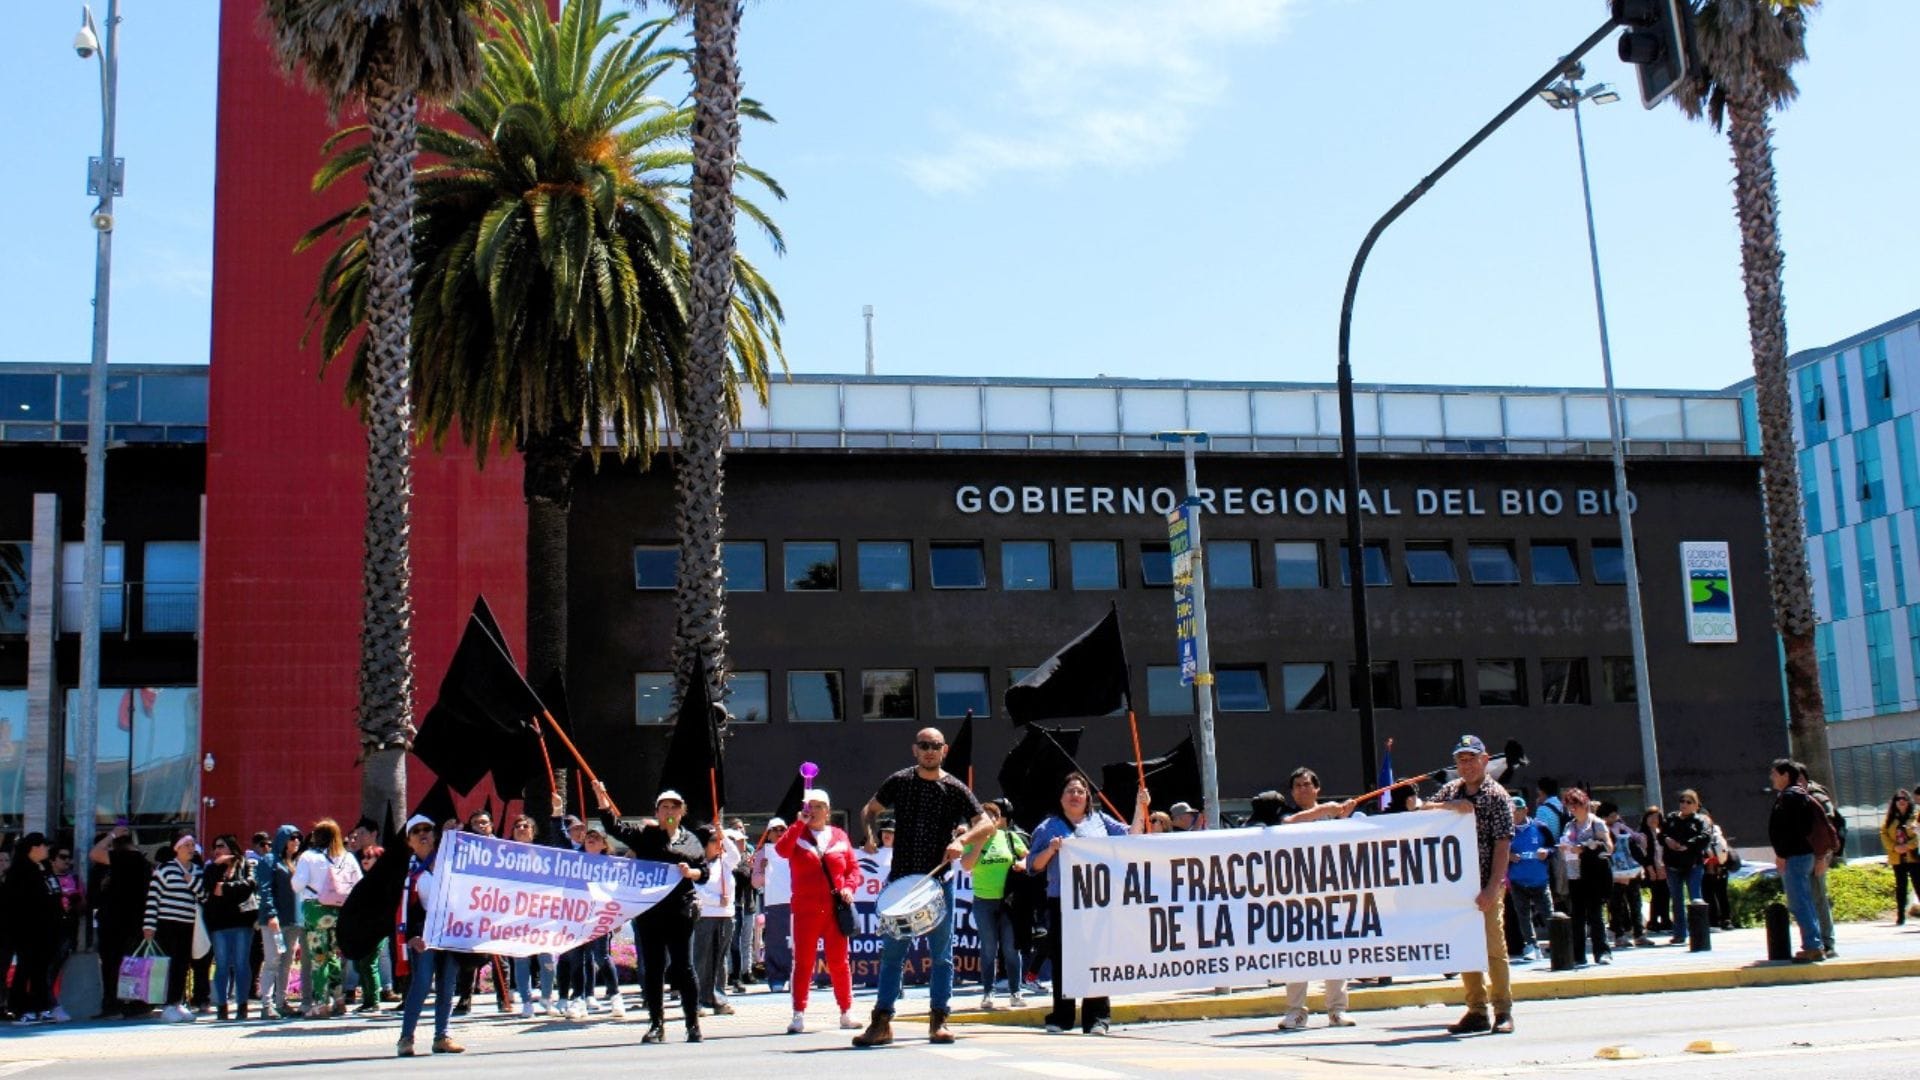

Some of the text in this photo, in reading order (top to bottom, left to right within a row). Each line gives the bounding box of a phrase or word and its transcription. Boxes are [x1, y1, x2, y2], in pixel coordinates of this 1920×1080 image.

[955, 485, 1638, 515] GOBIERNO REGIONAL DEL BIO BIO
[496, 843, 551, 876] Somos
[554, 852, 666, 888] Industriales!!
[1072, 835, 1463, 910] NO AL FRACCIONAMIENTO
[468, 885, 510, 914] Sólo
[446, 912, 474, 939] los
[478, 917, 552, 947] Puestos
[1149, 892, 1383, 953] DE LA POBREZA
[1090, 943, 1451, 983] TRABAJADORES PACIFICBLU PRESENTE!
